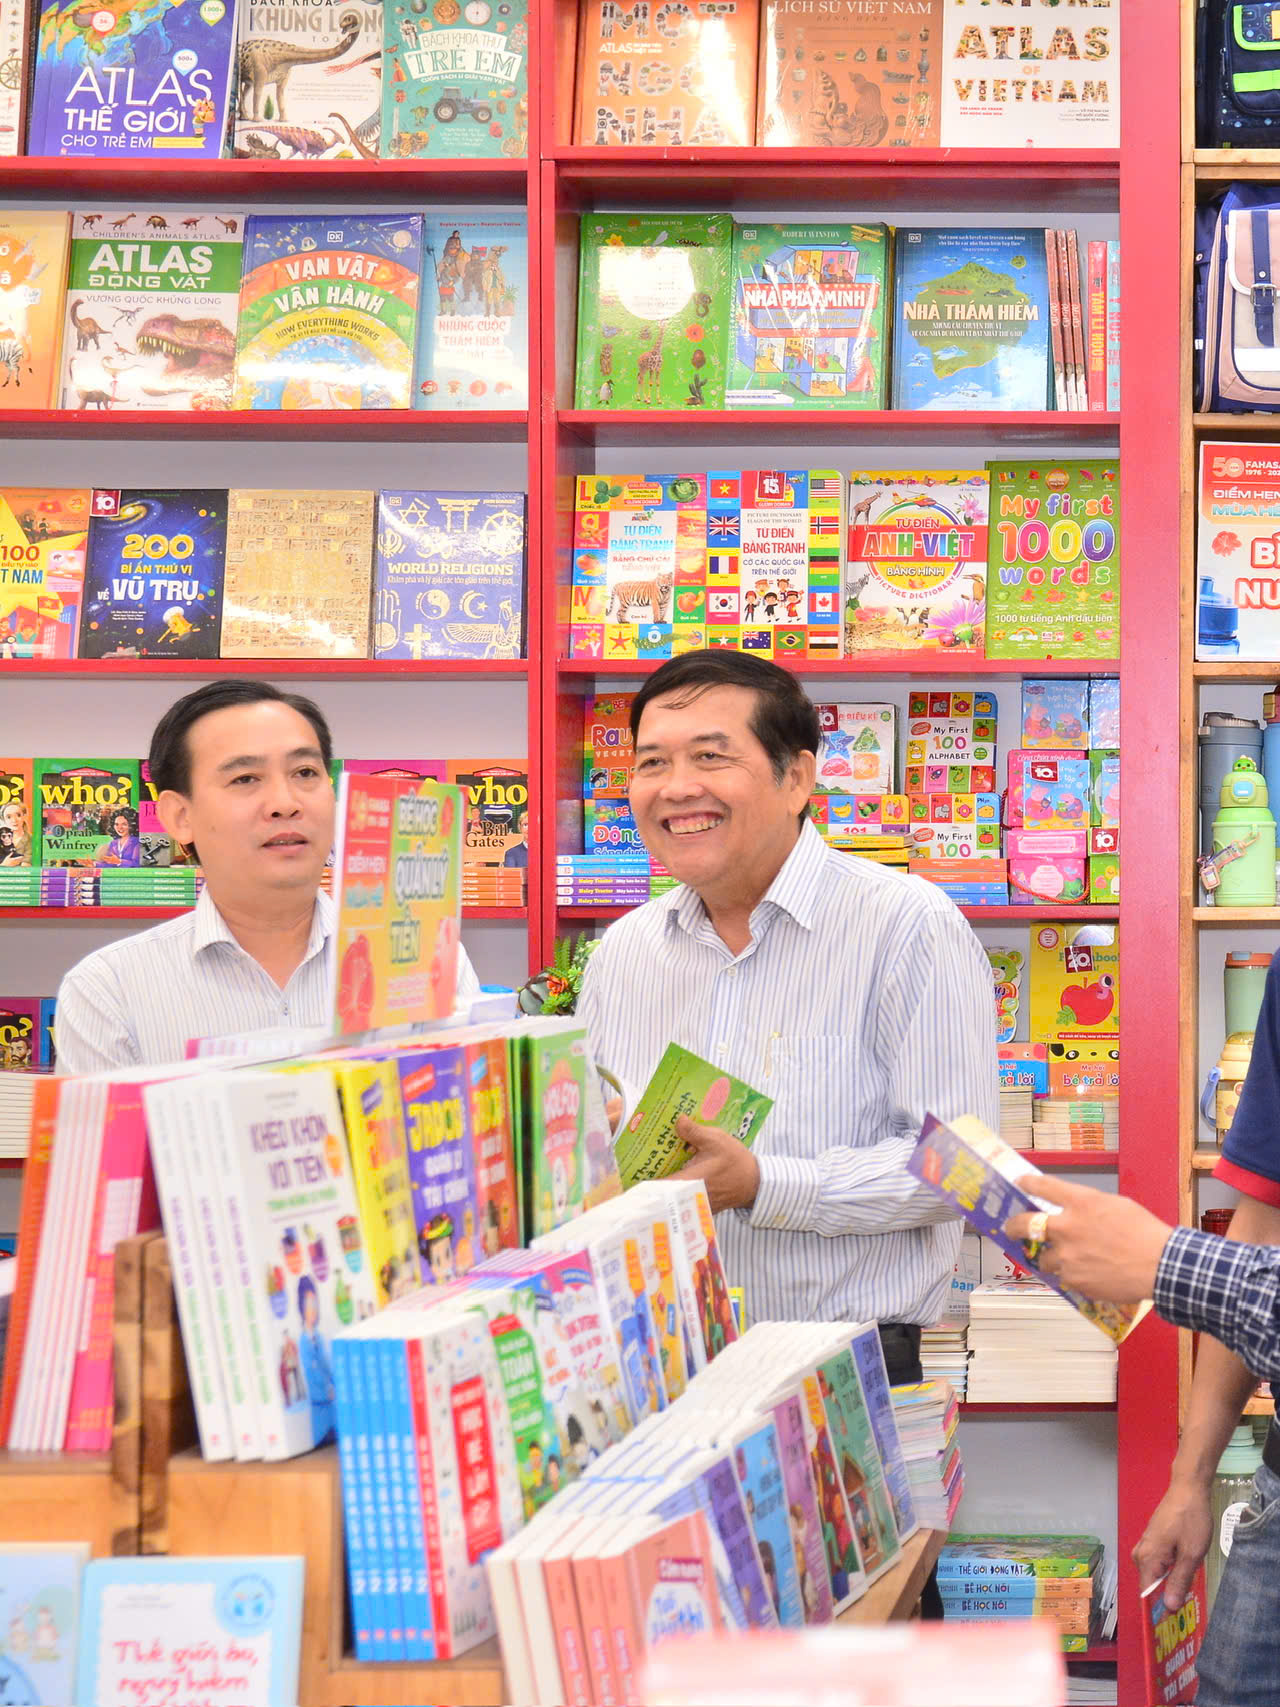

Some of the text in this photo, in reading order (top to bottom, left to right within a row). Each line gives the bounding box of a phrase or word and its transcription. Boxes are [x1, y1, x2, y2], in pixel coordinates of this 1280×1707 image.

[847, 1, 888, 15] VIỆT
[893, 2, 932, 14] NAM
[452, 32, 480, 46] KHOA
[953, 25, 1111, 61] ATLAS
[600, 43, 632, 53] ATLAS
[474, 50, 517, 78] EM
[1022, 65, 1041, 76] OF
[64, 66, 213, 107] ATLAS
[952, 79, 1111, 103] VIETNAM
[64, 100, 187, 133] THẾ GIỚI
[61, 131, 154, 148] CHO TRẺ EM
[150, 232, 189, 240] ANIMALS
[88, 243, 213, 274] ATLAS
[286, 254, 379, 281] VẠN VẬT
[89, 273, 211, 290] ĐỘNG VẬT
[86, 293, 222, 305] VƯƠNG QUỐC KHỦNG LONG
[274, 283, 386, 314] VẬN HÀNH
[903, 297, 1039, 321] NHÀ THÁM HIỂM
[297, 318, 350, 333] EVERYTHING
[351, 321, 381, 341] WORKS
[1212, 456, 1245, 478] 50
[1213, 486, 1252, 499] ĐIỂM
[1000, 493, 1115, 520] My first
[1212, 502, 1257, 517] MÙA
[771, 525, 795, 539] ĐIỂN
[121, 534, 195, 560] 200
[743, 540, 806, 555] BẰNG TRANH
[862, 530, 975, 559] ANH-VIỆT
[997, 519, 1116, 564] 1000
[120, 562, 132, 574] BÍ
[155, 562, 180, 575] THÚ
[182, 564, 192, 577] VỊ
[388, 562, 514, 575] WORLD RELIGIONS
[755, 558, 769, 566] CÁC
[771, 558, 792, 566] QUỐC
[793, 558, 806, 566] GIA
[19, 569, 43, 585] NAM
[752, 568, 768, 576] TRÊN
[918, 565, 945, 577] HÌNH
[999, 559, 1111, 586] words
[112, 574, 199, 606] VŨ TRỤ
[875, 575, 957, 599] PICTURE DICTIONARY
[592, 724, 634, 748] Rau
[934, 726, 969, 735] My First
[933, 736, 967, 750] 100
[929, 752, 971, 760] ALPHABET
[38, 776, 132, 805] who?
[51, 825, 93, 840] Oprah
[482, 821, 509, 837] Bill
[937, 832, 973, 841] My First
[47, 838, 99, 853] Winfrey
[465, 831, 506, 849] Gates
[937, 843, 972, 858] 100
[1063, 1074, 1120, 1086] bé trả lờ
[951, 1277, 975, 1292] bạn
[959, 1562, 1024, 1577] THẾ GIỚI ĐỘNG VẬT
[964, 1582, 1010, 1595] BÉ HỌC NÓI
[961, 1599, 1008, 1612] BÉ HỌC NÓI
